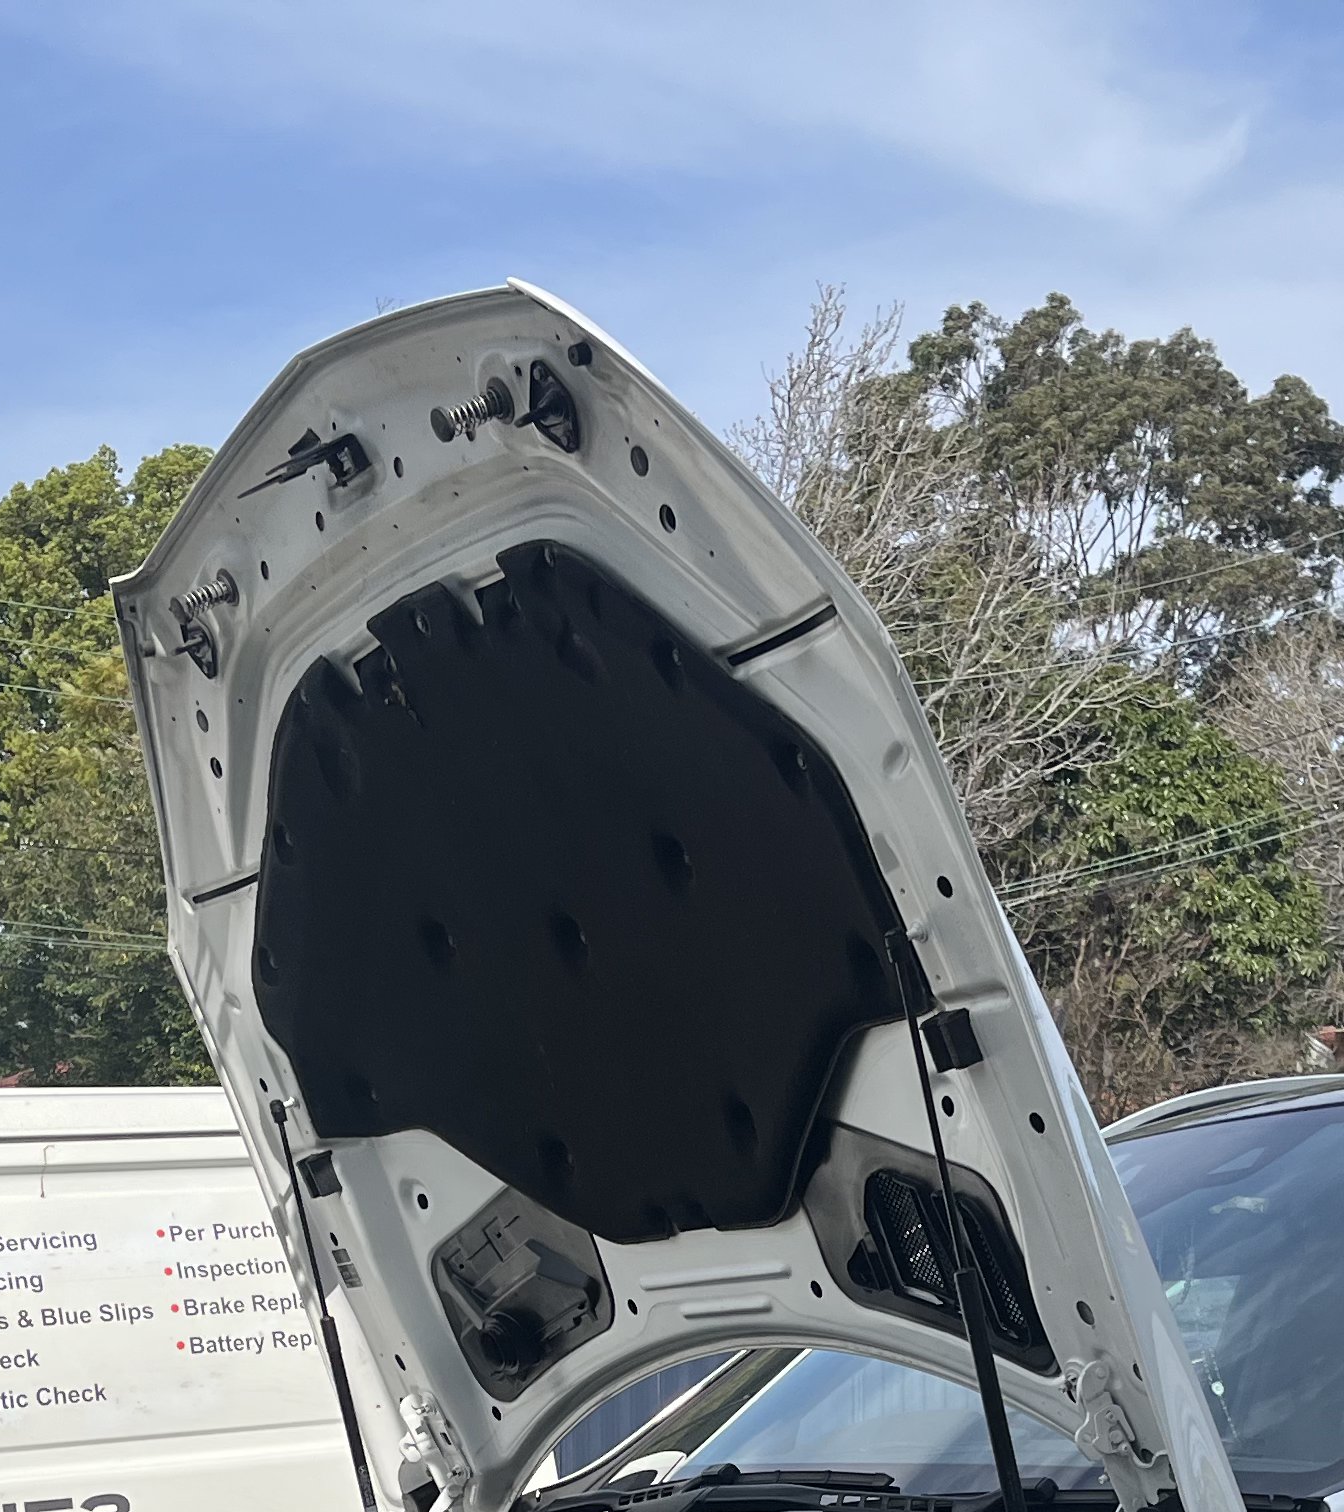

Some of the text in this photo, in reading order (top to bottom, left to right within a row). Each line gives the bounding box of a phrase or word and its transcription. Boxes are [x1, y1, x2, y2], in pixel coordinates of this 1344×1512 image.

[169, 1221, 278, 1243] Per Purch
[177, 1257, 287, 1282] Inspection
[17, 1309, 35, 1329] &
[40, 1306, 92, 1327] Blue
[99, 1302, 154, 1326] Slips
[184, 1296, 245, 1317] Brake
[189, 1334, 265, 1355] Battery
[36, 1383, 107, 1407] Check
